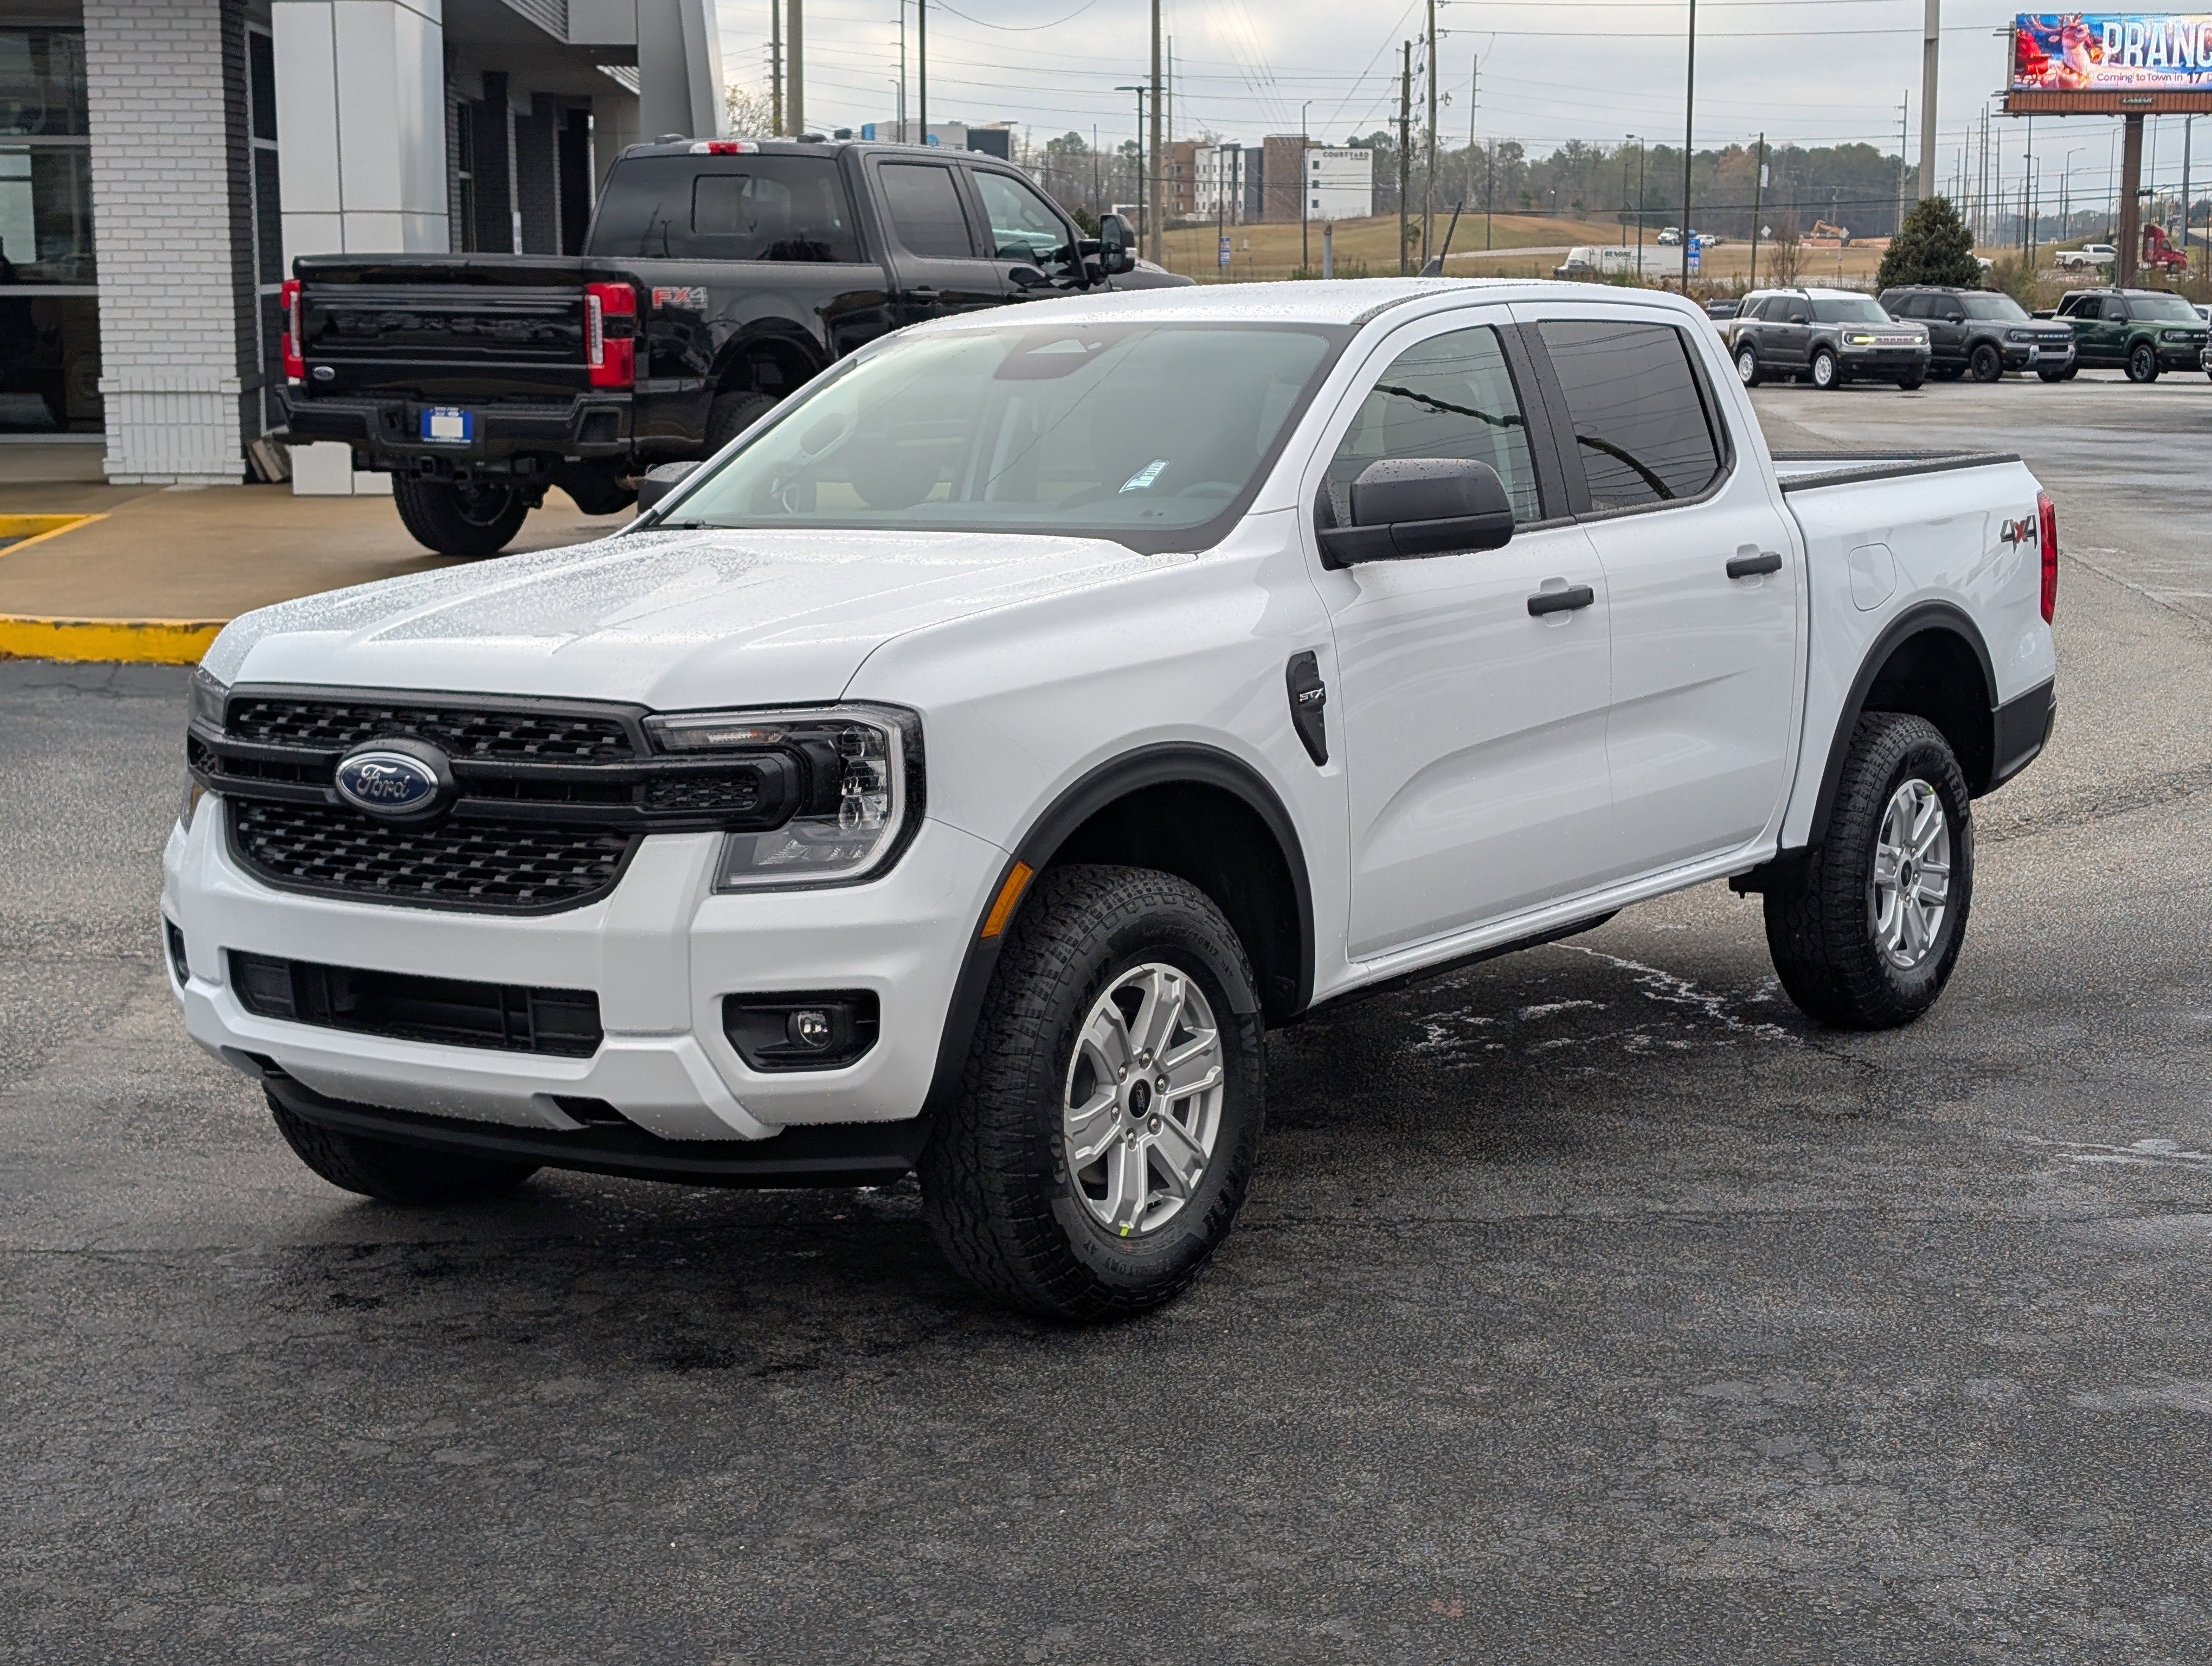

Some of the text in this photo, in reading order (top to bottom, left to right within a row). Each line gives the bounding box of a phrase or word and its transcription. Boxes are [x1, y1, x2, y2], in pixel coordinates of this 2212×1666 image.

[2097, 73, 2133, 83] Coming
[2187, 72, 2203, 83] 17
[652, 286, 708, 309] FX4
[1299, 688, 1324, 702] STX
[356, 764, 410, 799] Ford
